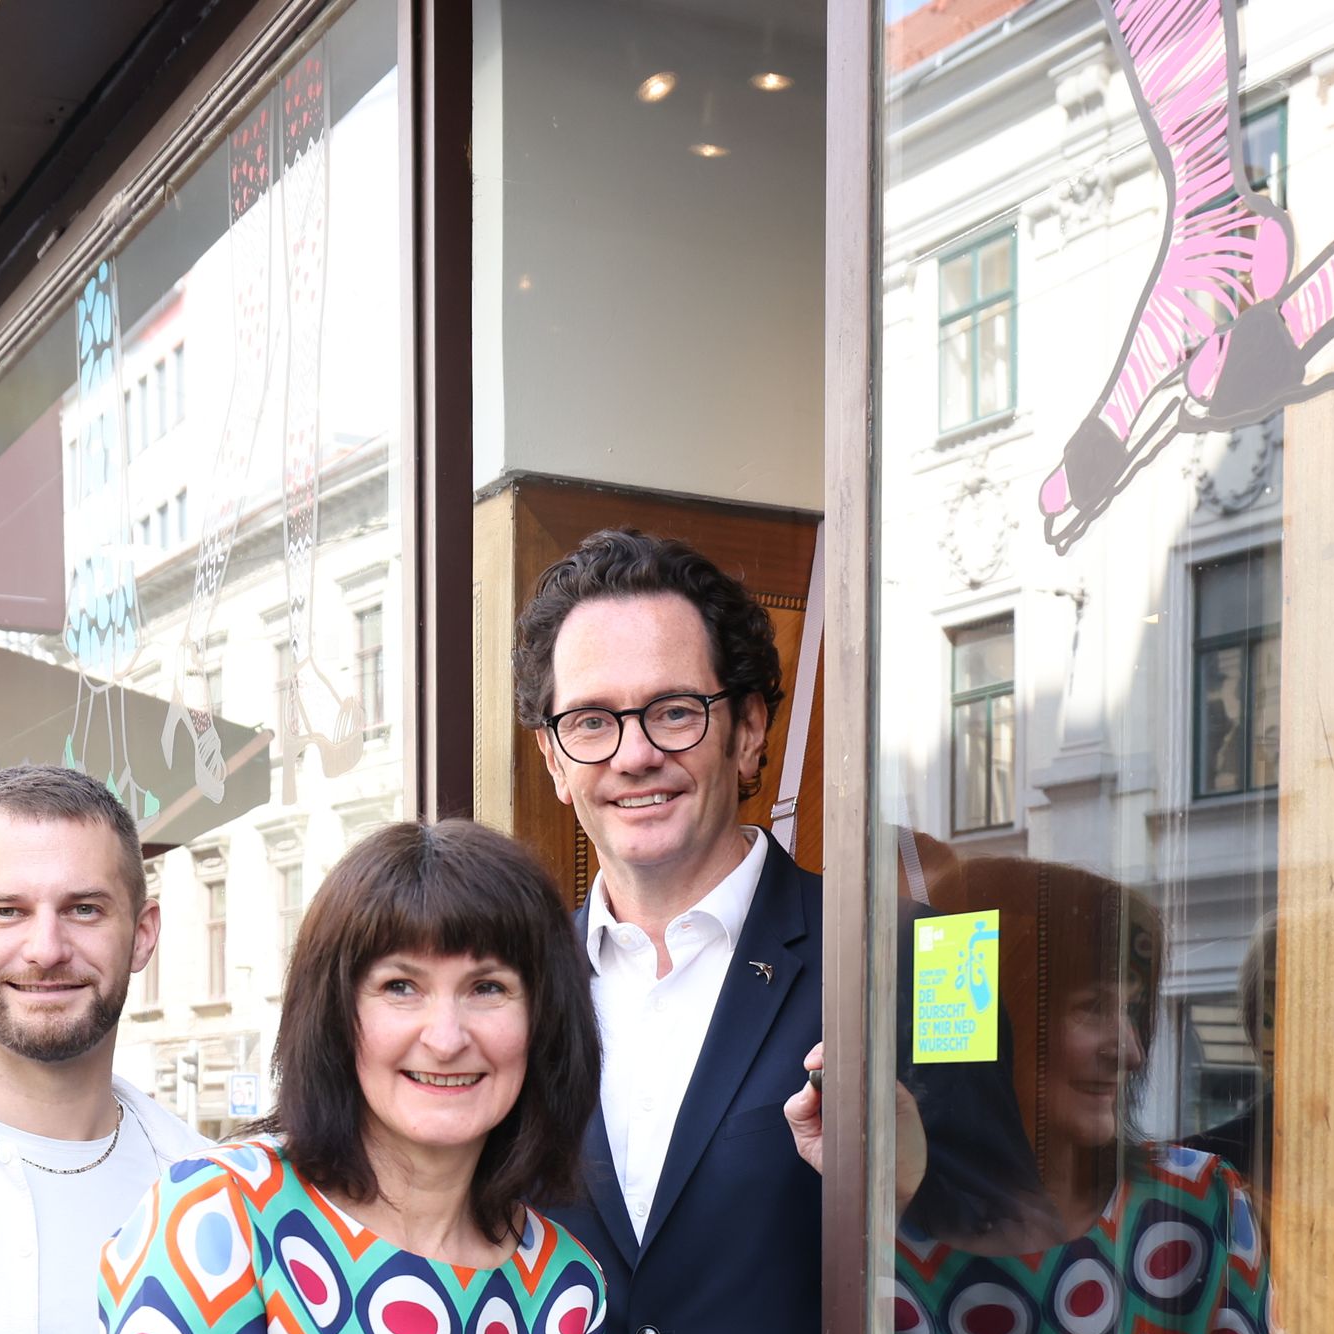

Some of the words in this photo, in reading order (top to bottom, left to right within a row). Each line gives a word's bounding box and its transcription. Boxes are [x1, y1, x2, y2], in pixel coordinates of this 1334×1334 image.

[918, 988, 936, 1003] DEI
[918, 1004, 966, 1019] DURSCHT
[932, 1020, 950, 1035] MIR
[954, 1019, 975, 1034] NED
[918, 1036, 969, 1053] WURSCHT
